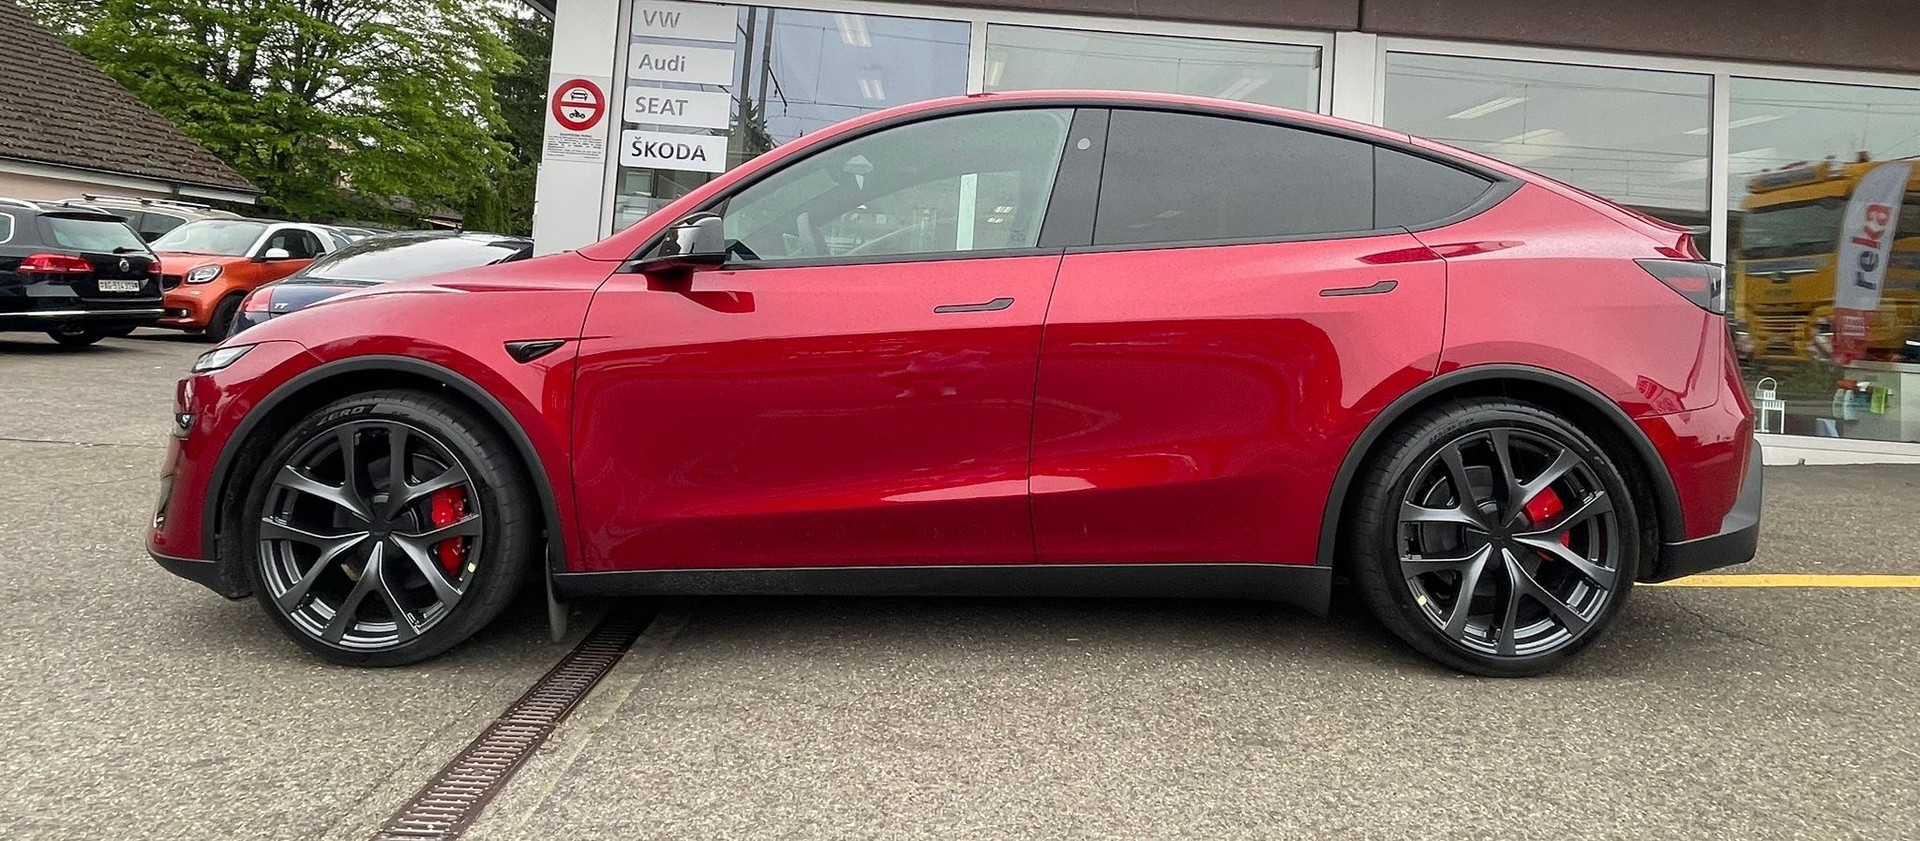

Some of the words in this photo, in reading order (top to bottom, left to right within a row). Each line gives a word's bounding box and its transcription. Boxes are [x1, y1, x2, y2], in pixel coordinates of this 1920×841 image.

[643, 9, 681, 28] VW
[638, 53, 686, 73] Audi
[635, 96, 688, 116] SEAT
[631, 136, 707, 162] ŠKODA
[1851, 203, 1892, 291] reka
[316, 405, 365, 427] ZERO
